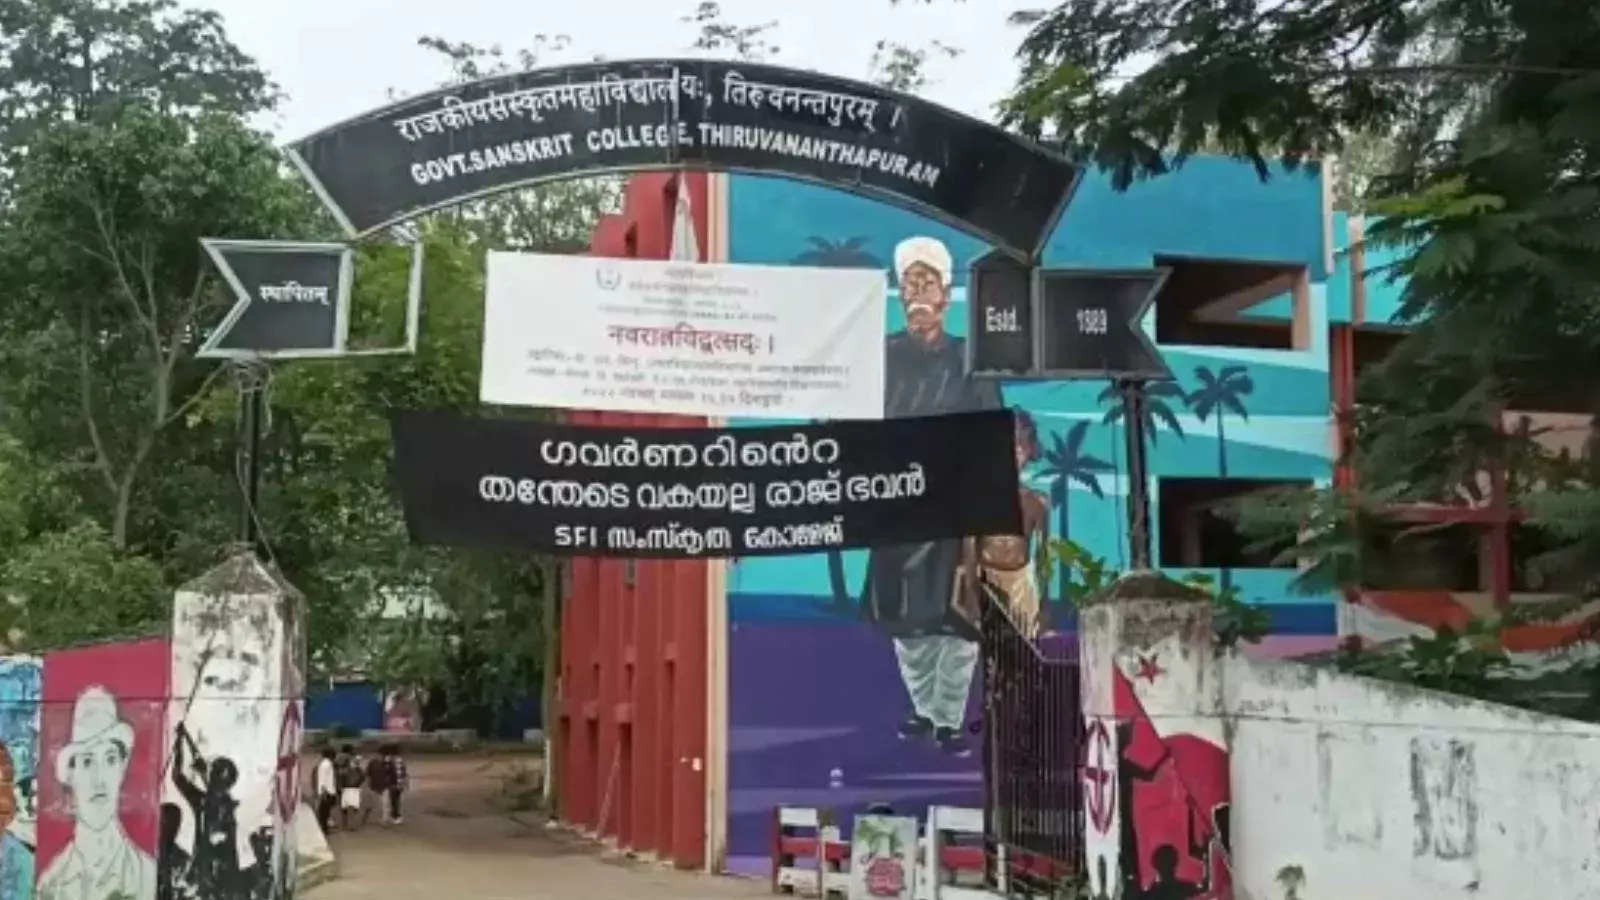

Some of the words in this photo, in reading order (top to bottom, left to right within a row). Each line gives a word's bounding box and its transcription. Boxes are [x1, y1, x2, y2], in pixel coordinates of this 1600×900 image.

[698, 122, 941, 188] THIRUVANANTHAPURAM
[637, 482, 756, 514] വകയല്ല
[554, 525, 597, 547] SFI
